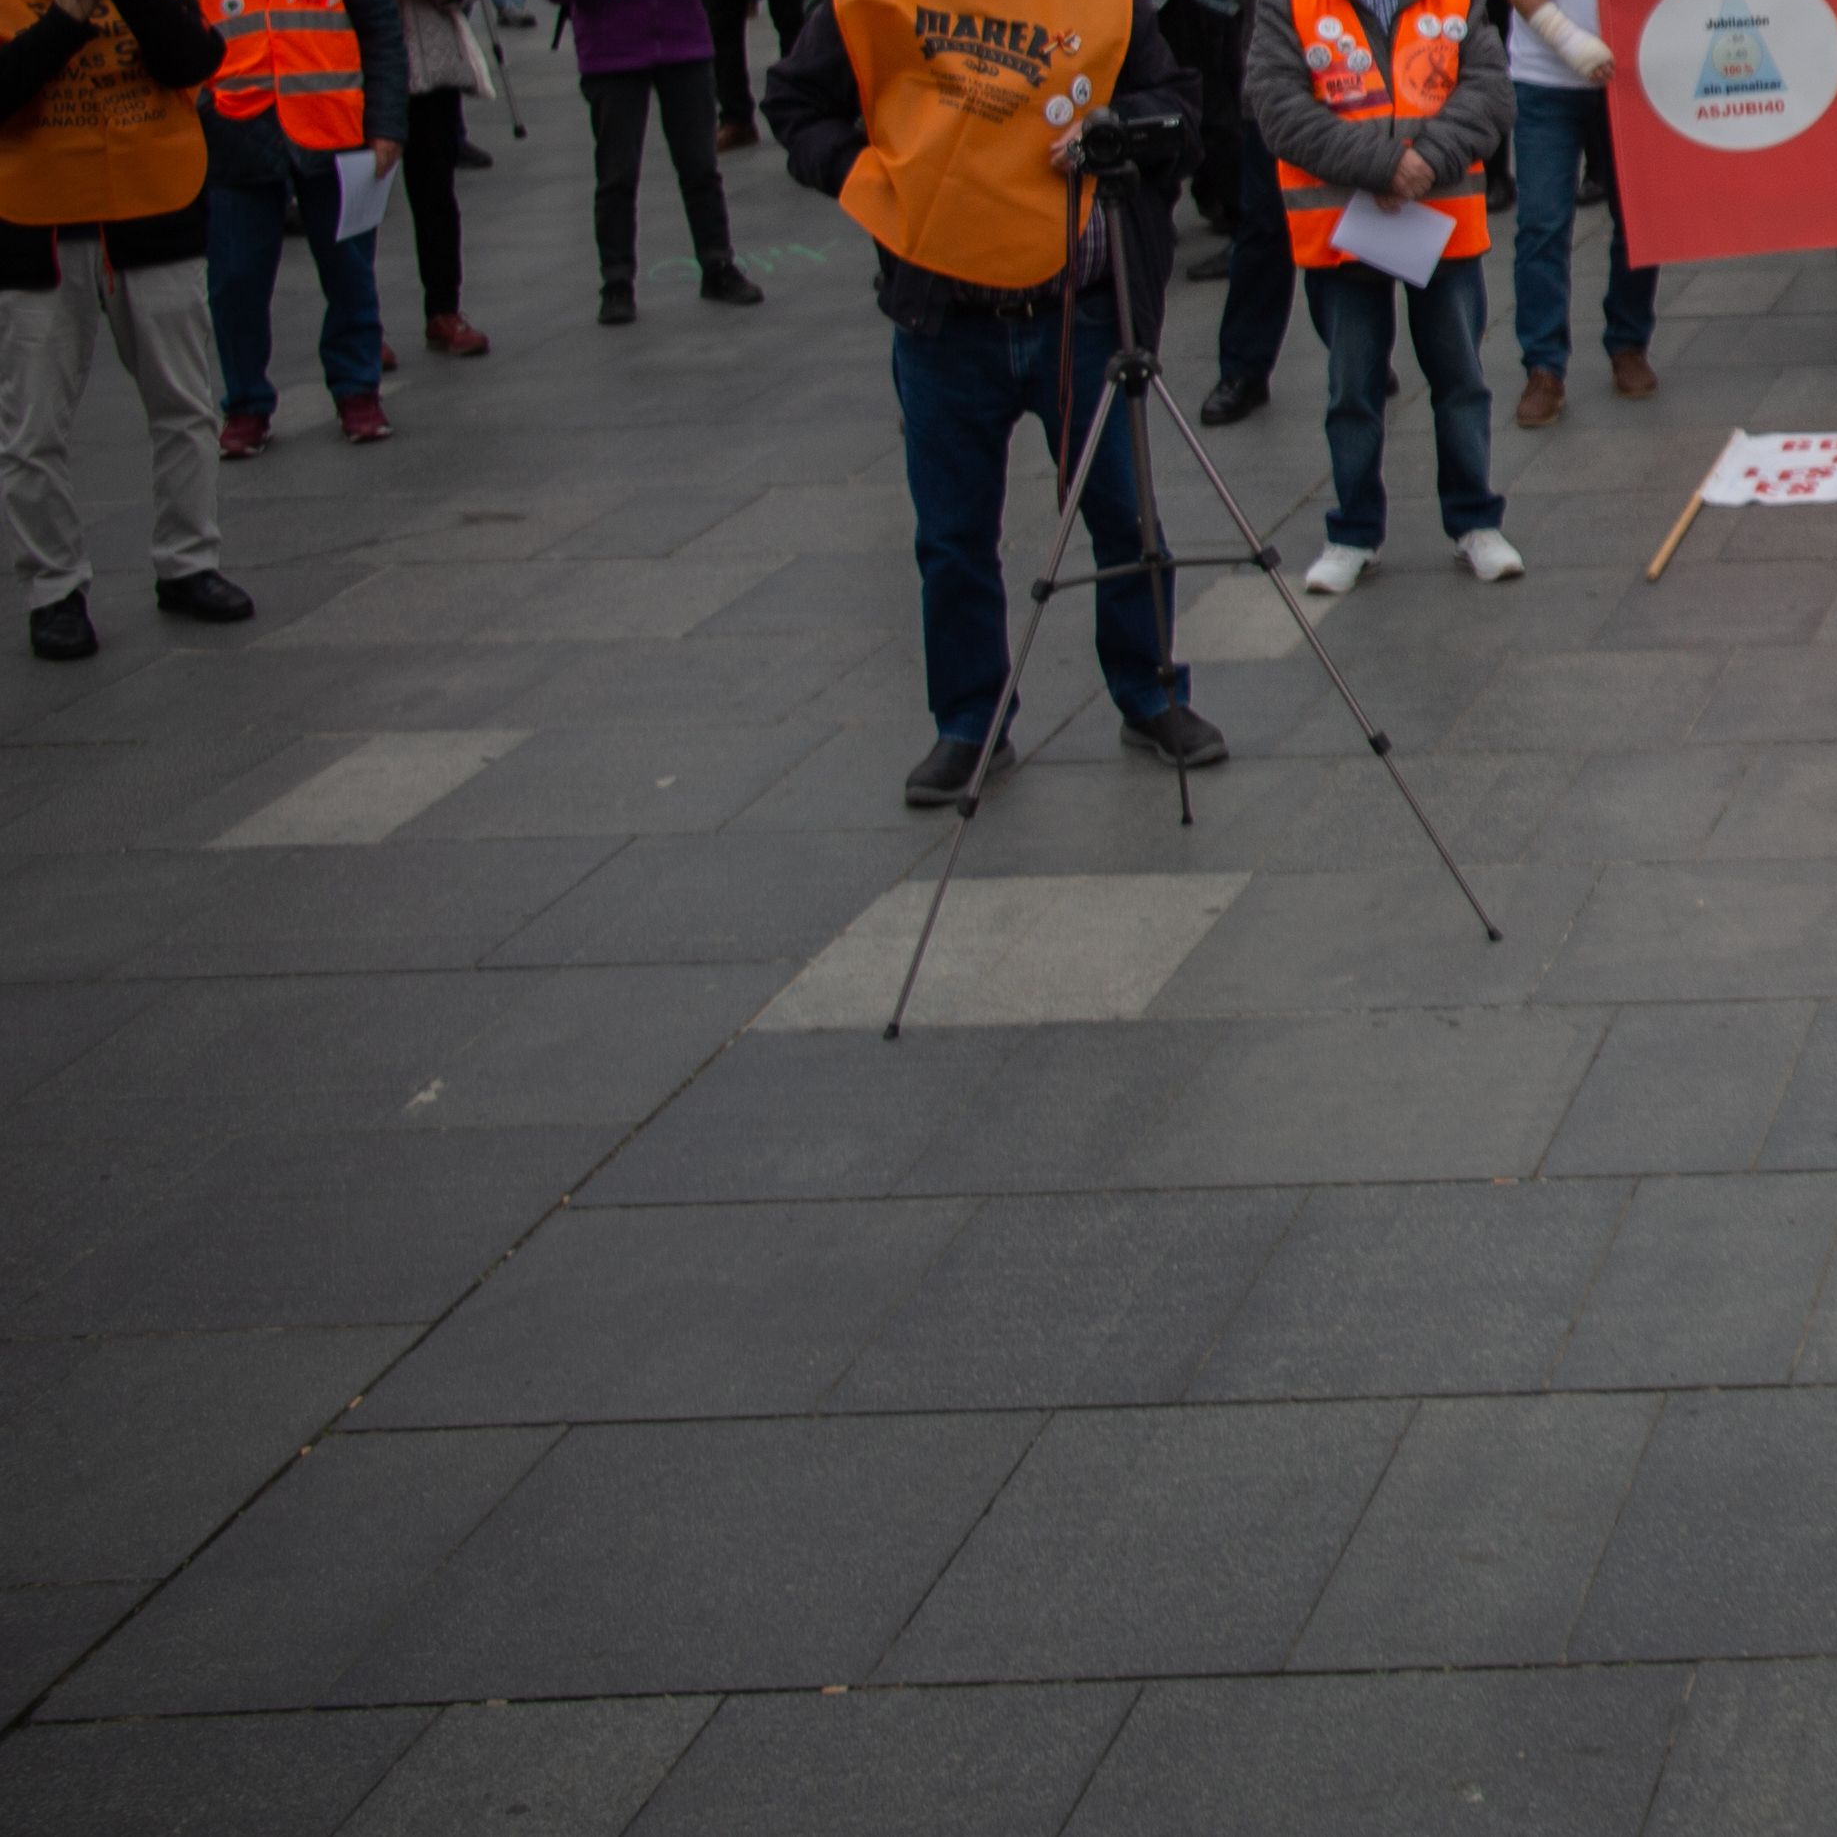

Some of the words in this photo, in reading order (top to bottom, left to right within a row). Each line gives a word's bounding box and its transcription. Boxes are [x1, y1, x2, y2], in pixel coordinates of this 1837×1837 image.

[1705, 15, 1770, 31] Jubilación
[914, 4, 1052, 69] MAREA
[1703, 84, 1723, 96] sin
[1725, 79, 1783, 97] penalizar
[1696, 100, 1786, 122] ASJUBI40
